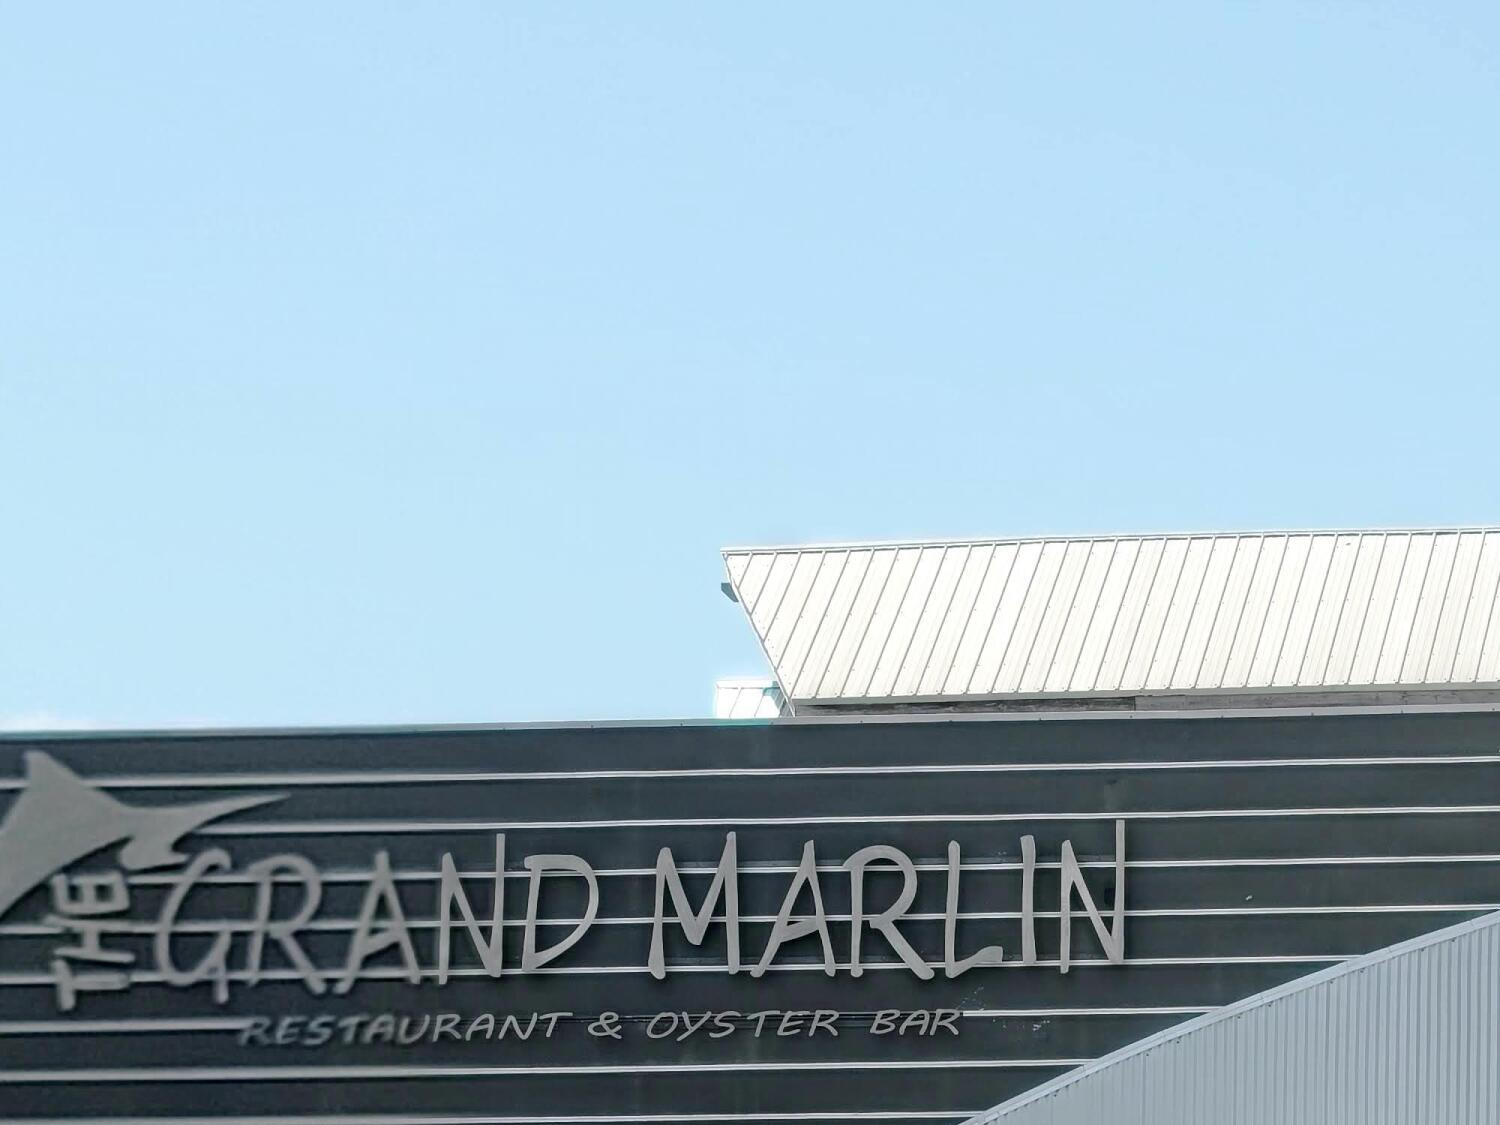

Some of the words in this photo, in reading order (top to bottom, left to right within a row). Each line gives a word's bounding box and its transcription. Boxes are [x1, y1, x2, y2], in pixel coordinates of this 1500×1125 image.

[43, 869, 135, 1011] THE
[154, 832, 600, 1003] GRAND
[647, 819, 1126, 980] MARLIN
[238, 1010, 573, 1046] RESTAURANT
[587, 1010, 623, 1038] &
[646, 1008, 840, 1042] OYSTER
[869, 1008, 961, 1037] BAR
